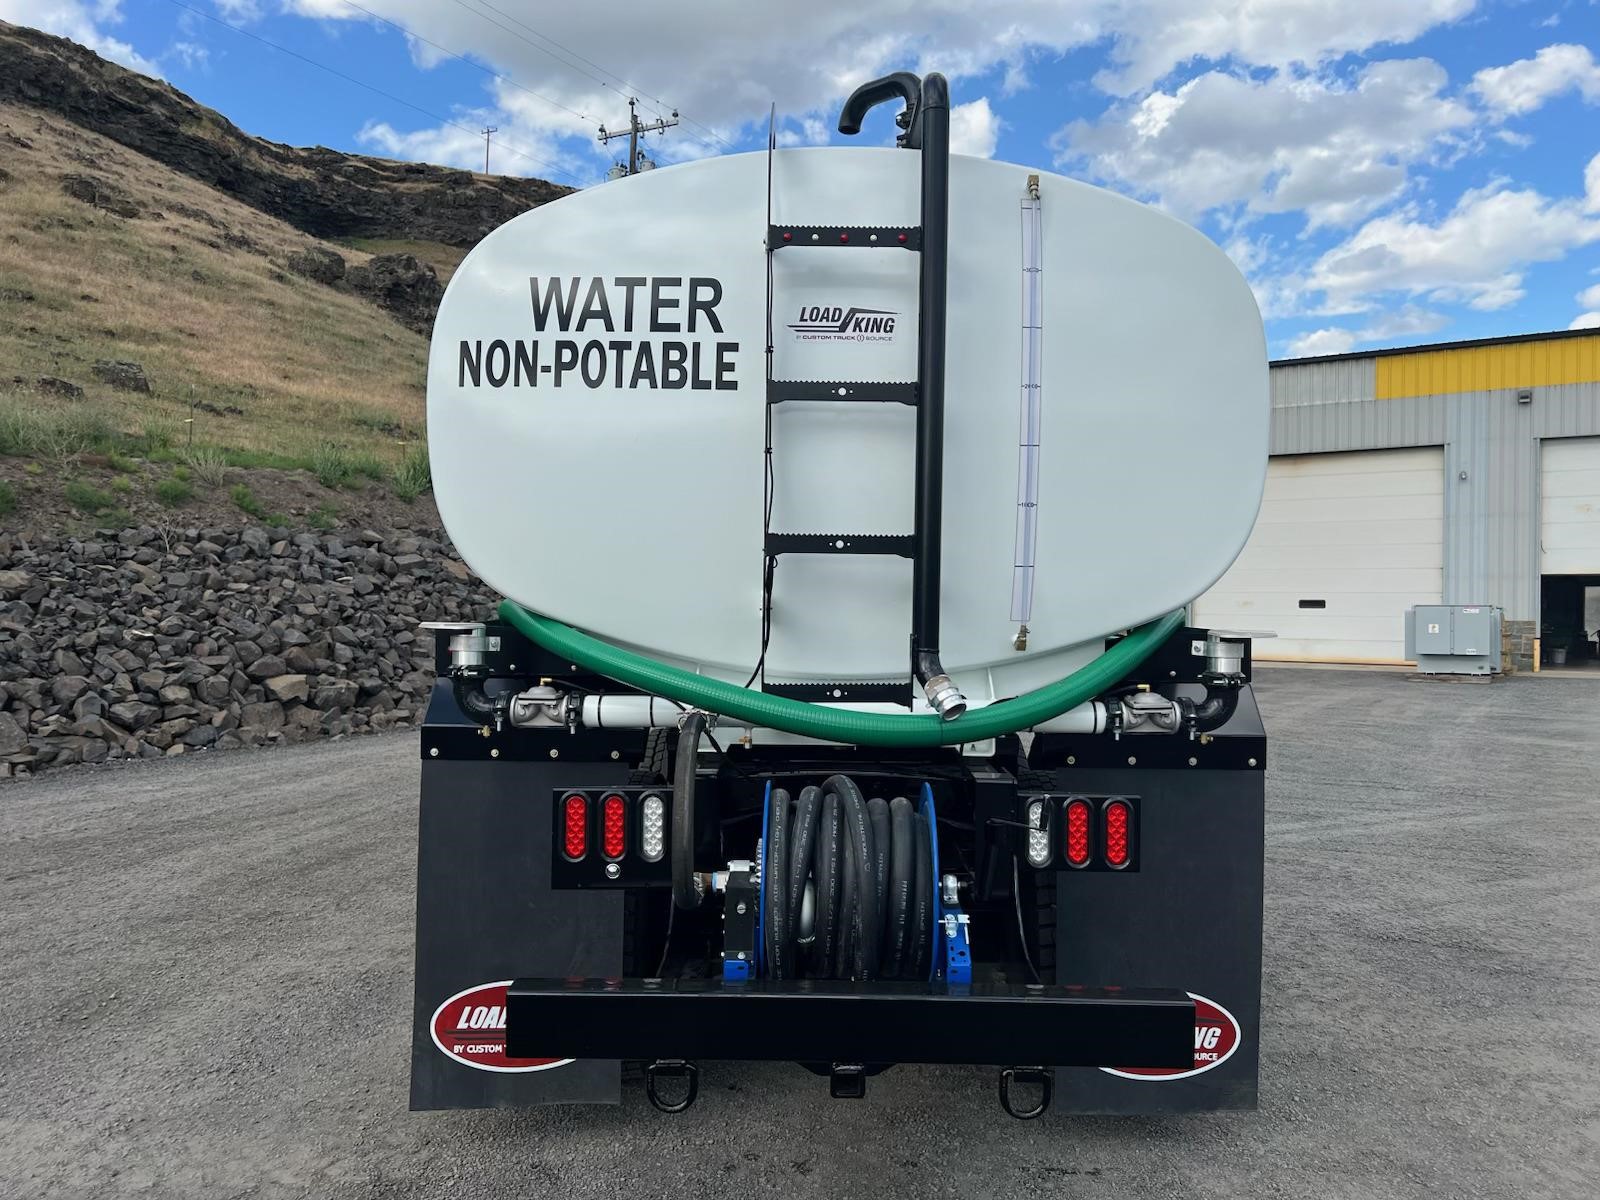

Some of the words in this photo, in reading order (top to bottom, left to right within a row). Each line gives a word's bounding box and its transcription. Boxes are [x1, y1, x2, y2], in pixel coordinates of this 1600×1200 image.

[530, 277, 724, 333] WATER
[799, 307, 843, 323] LOAD
[852, 317, 895, 333] KING
[458, 340, 740, 391] NON-POTABLE
[453, 1045, 464, 1053] BY
[467, 1044, 502, 1053] CUSTOM
[1194, 1026, 1222, 1050] NG
